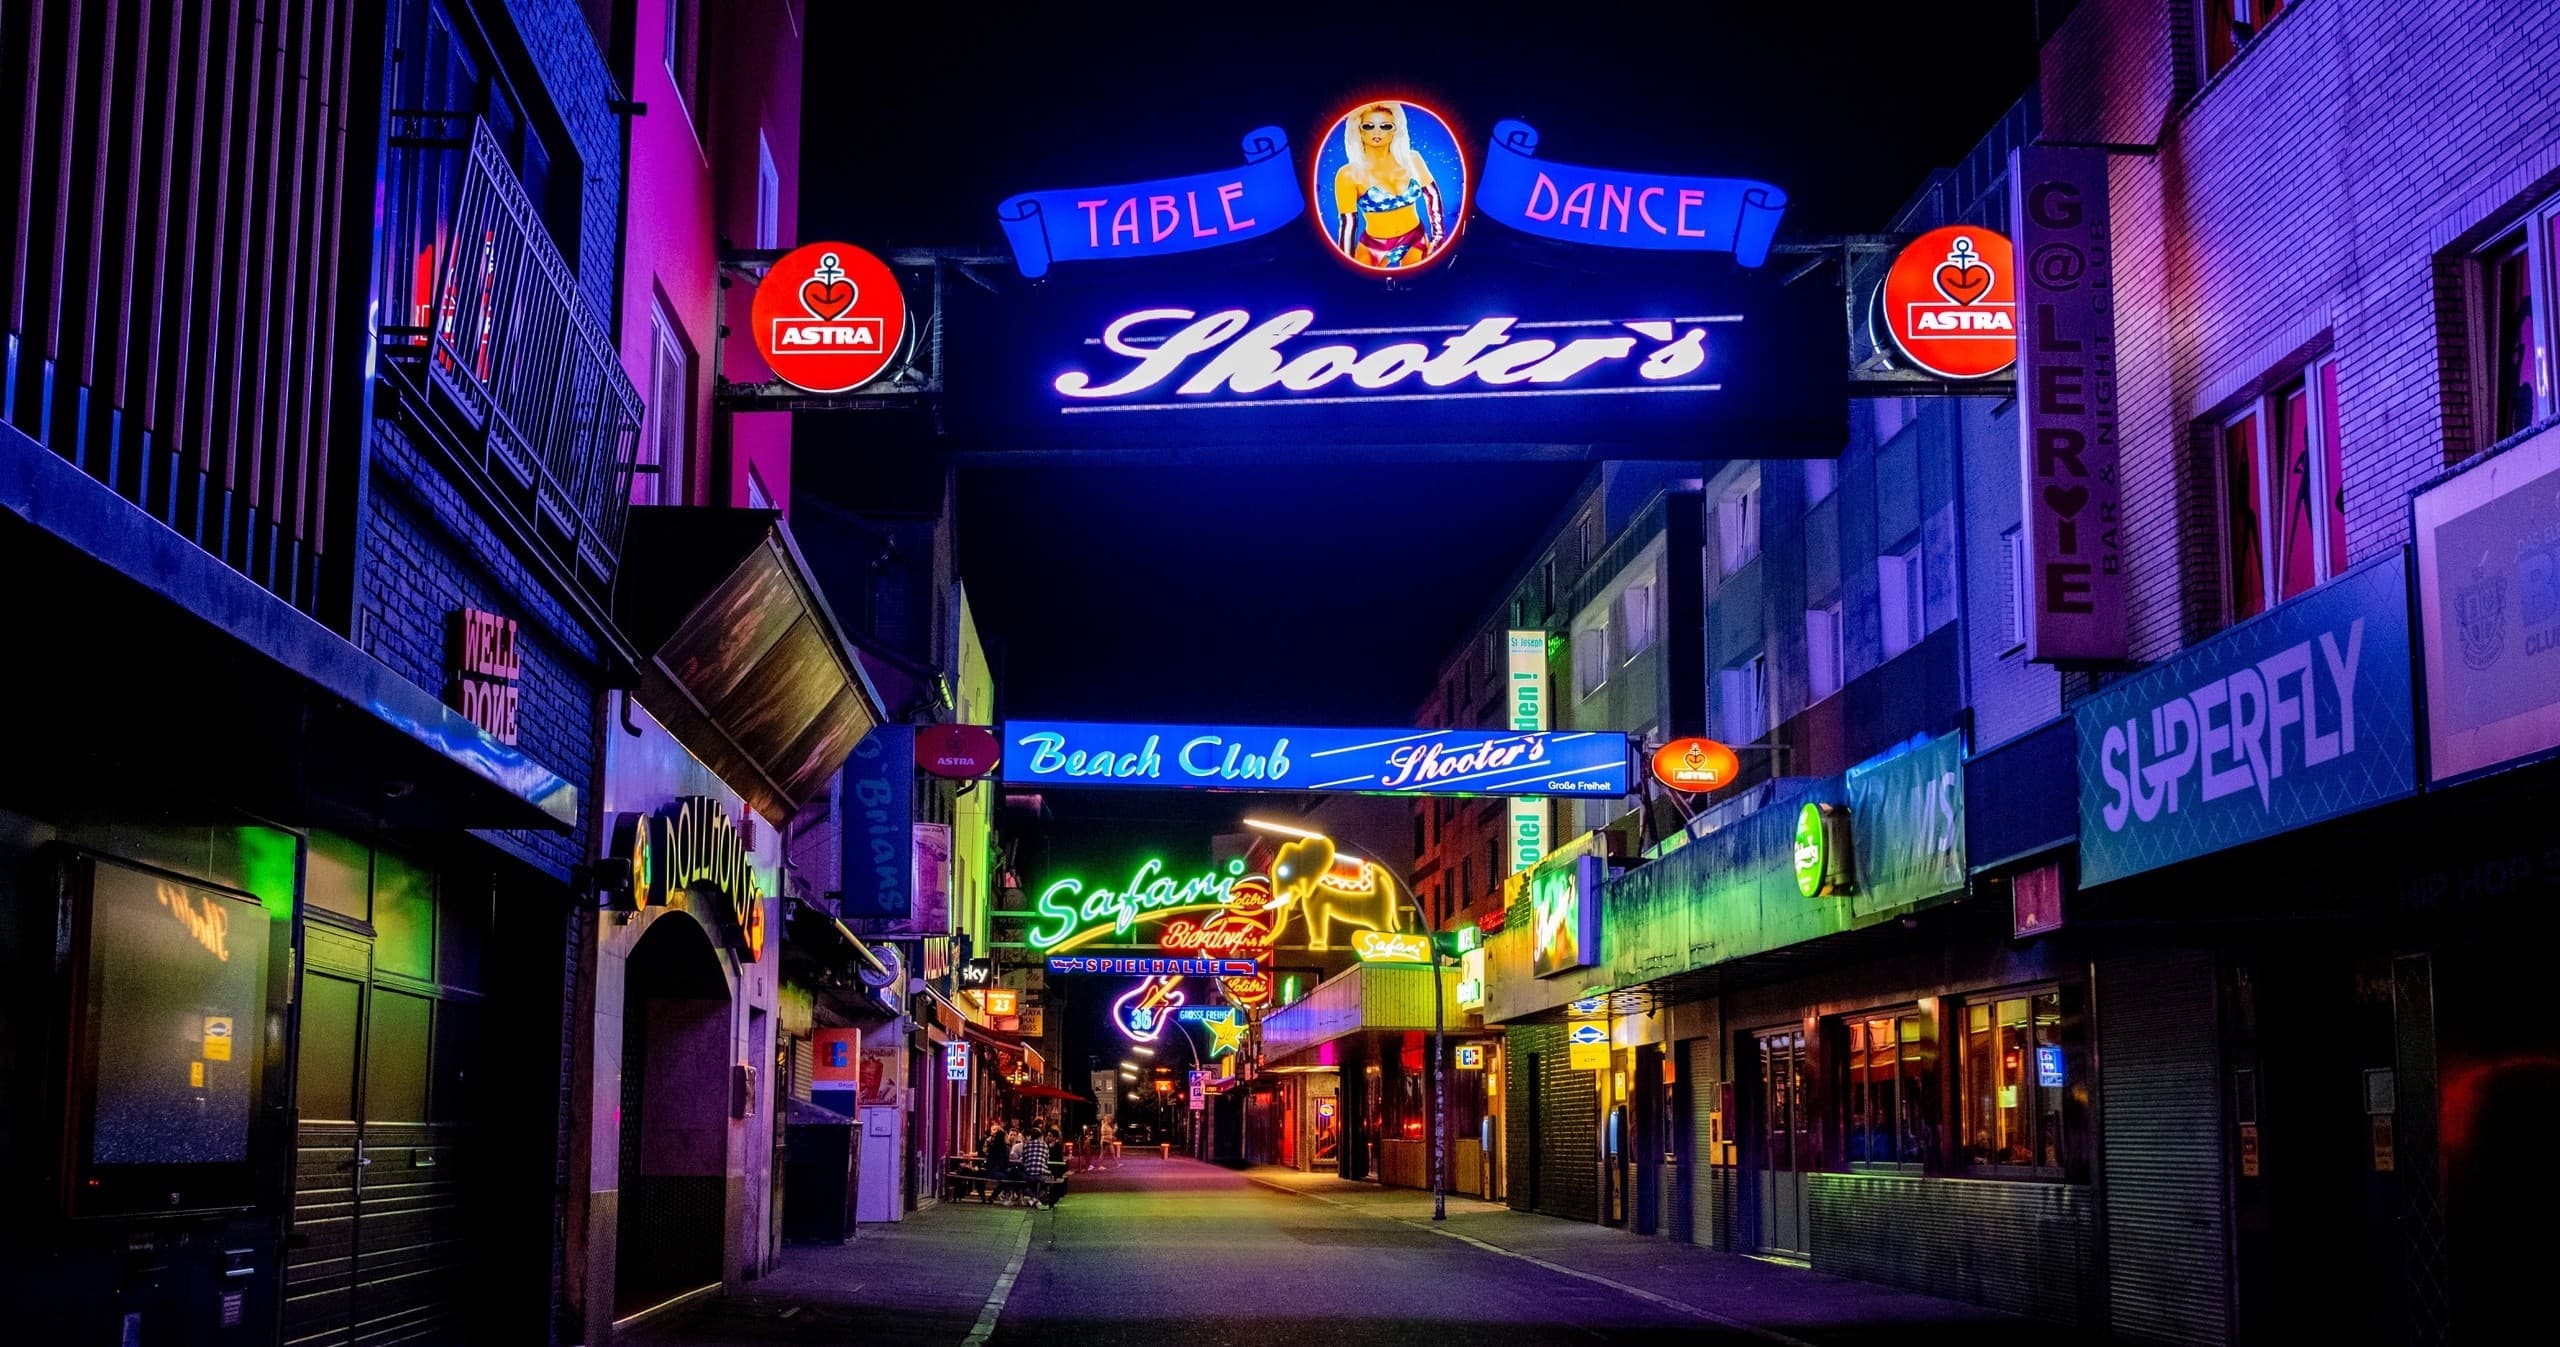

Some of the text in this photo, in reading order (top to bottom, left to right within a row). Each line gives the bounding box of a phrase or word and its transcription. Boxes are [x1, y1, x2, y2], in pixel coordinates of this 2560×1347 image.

[1078, 172, 1706, 248] TABLE DANCE
[781, 326, 874, 345] ASTRA
[1918, 311, 2013, 330] ASTRA
[1054, 305, 1706, 398] Shooter's
[2090, 219, 2119, 575] BAR & NIGHT CLUB
[465, 608, 520, 680] WELL
[463, 679, 519, 746] DONE
[2101, 617, 2365, 833] SUPERFLY
[937, 757, 976, 766] ASTRA
[1018, 732, 1544, 787] Beach Club Shooter's
[1548, 781, 1611, 791] Große Freiheit
[1676, 771, 1715, 781] ASTRA
[1515, 815, 1541, 871] otel
[665, 797, 757, 949] DOLLHOUSE
[1161, 921, 1254, 955] Bierdorf
[1086, 959, 1221, 973] SPIELHALLE
[1131, 1009, 1152, 1030] 36
